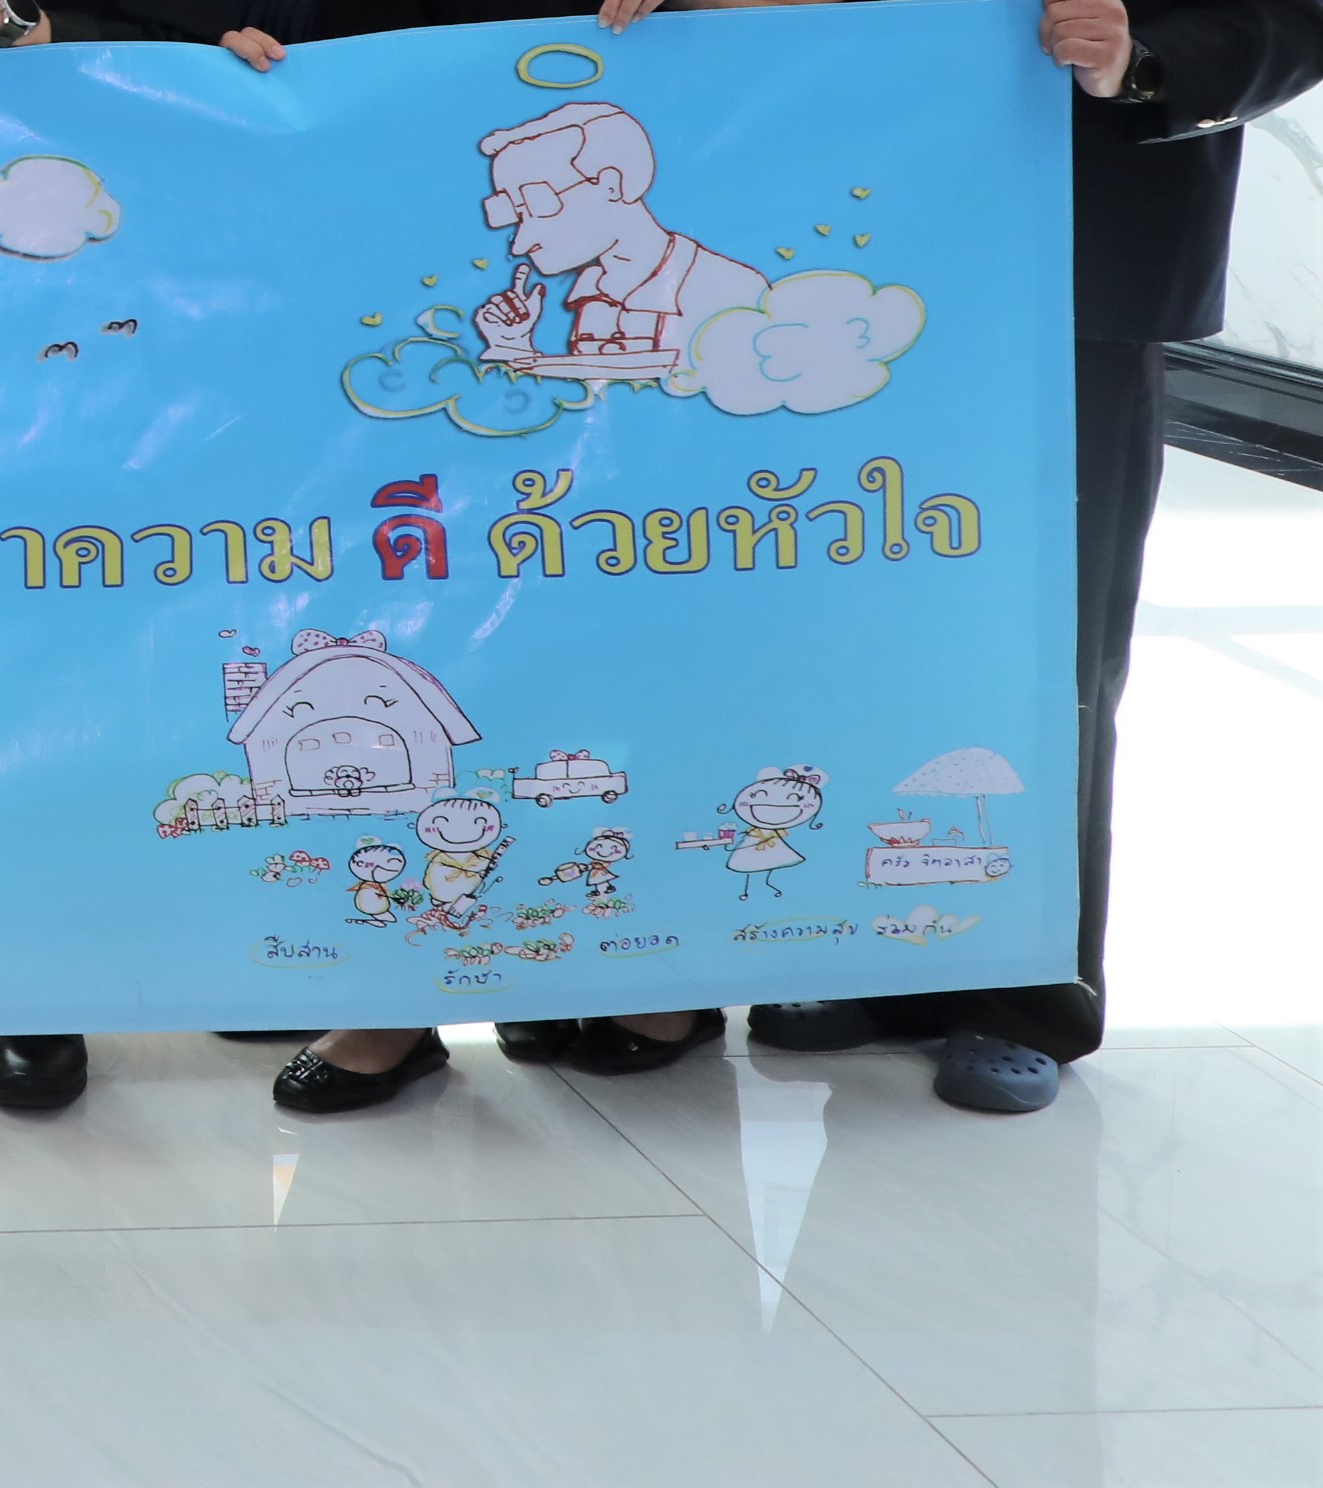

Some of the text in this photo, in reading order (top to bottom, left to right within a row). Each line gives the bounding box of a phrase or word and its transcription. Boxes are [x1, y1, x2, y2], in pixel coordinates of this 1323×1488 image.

[370, 473, 450, 583] ดี
[486, 455, 984, 579] ด้วยหัวใจ
[264, 934, 339, 961] สืบสาน
